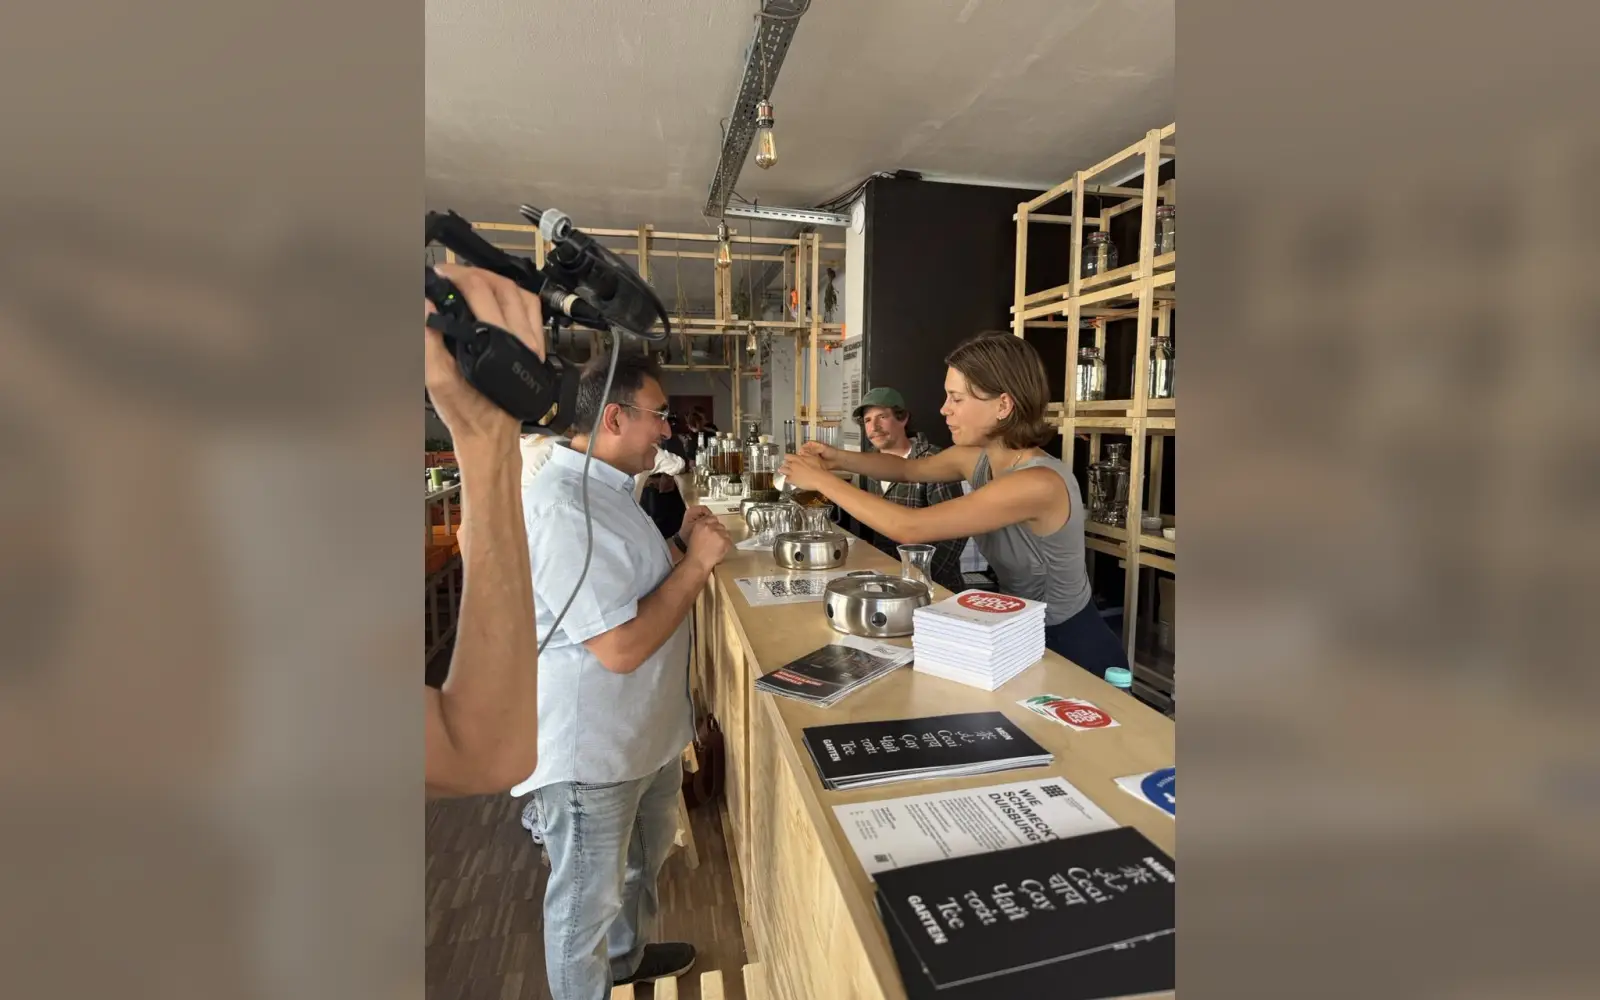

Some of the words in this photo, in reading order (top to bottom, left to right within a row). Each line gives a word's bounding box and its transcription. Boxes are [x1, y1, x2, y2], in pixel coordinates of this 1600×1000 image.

[511, 360, 545, 395] SONY
[823, 738, 842, 762] GARTEN
[841, 740, 857, 756] Tee
[899, 734, 920, 752] Çay
[938, 729, 963, 748] Ceai
[1018, 788, 1044, 807] WIE
[988, 793, 1047, 843] DUISBURG
[1018, 878, 1057, 911] Çay
[1049, 872, 1087, 906] चाय
[1067, 867, 1114, 904] Ceai
[907, 895, 949, 945] GARTEN
[936, 896, 965, 929] Tee
